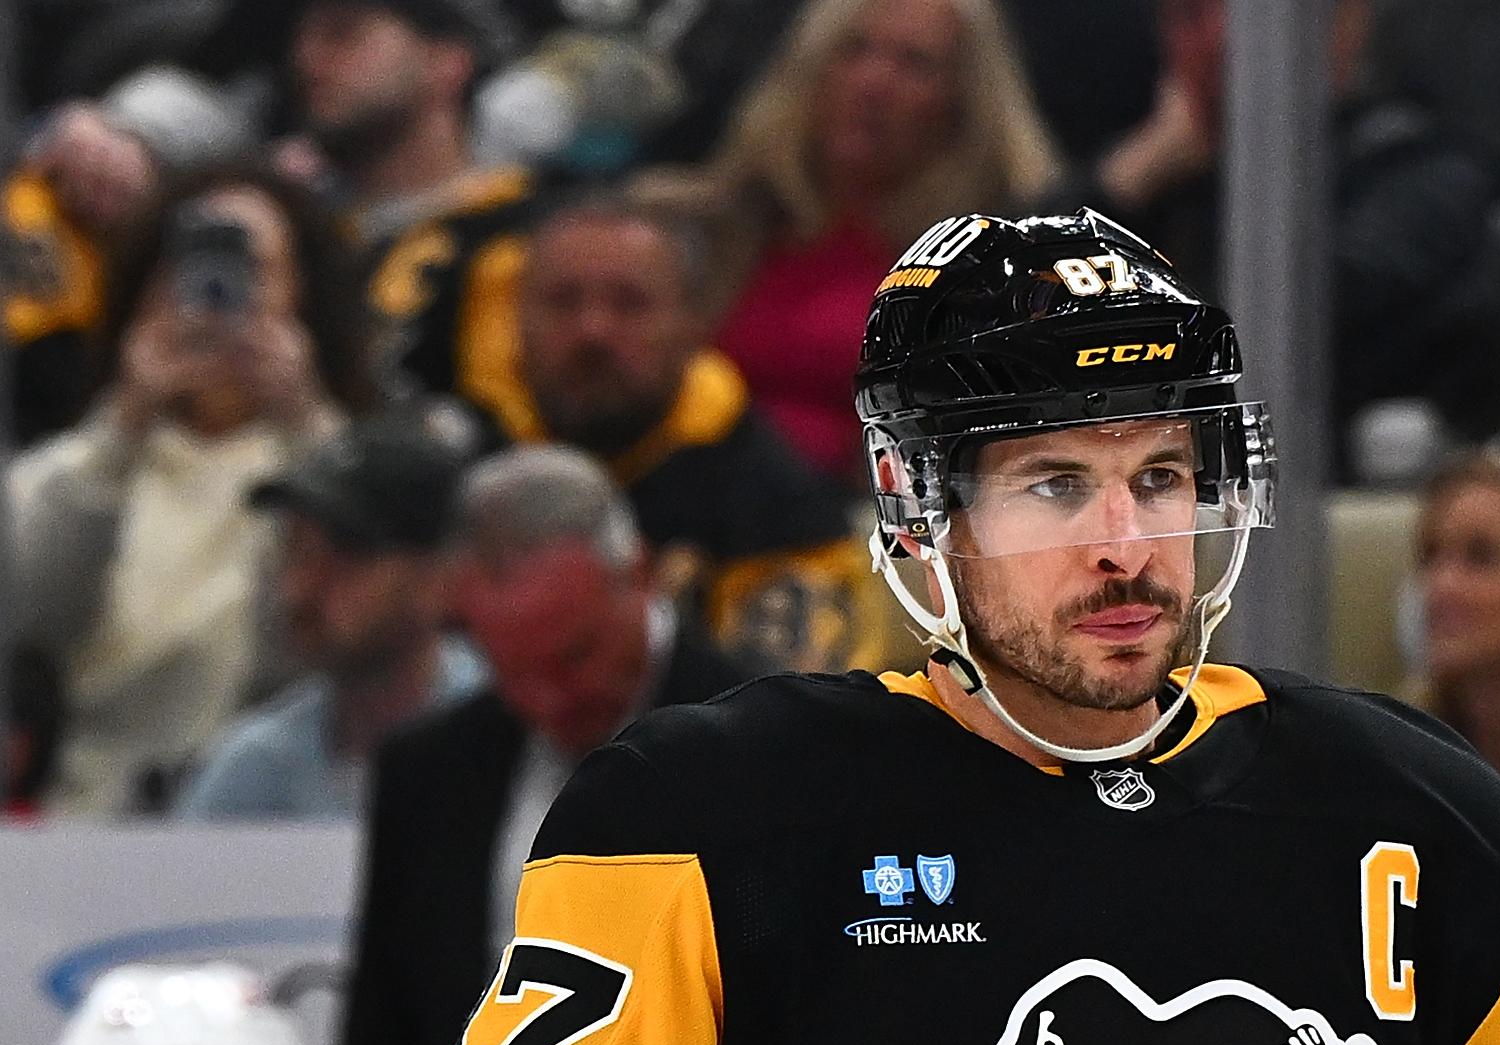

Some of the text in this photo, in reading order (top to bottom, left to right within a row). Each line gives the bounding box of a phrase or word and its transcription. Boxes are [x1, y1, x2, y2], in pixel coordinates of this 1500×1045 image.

[888, 215, 984, 274] OLD
[1053, 255, 1138, 297] 87
[1076, 343, 1177, 368] CCM
[1110, 779, 1137, 802] NHL
[1360, 841, 1421, 1021] C
